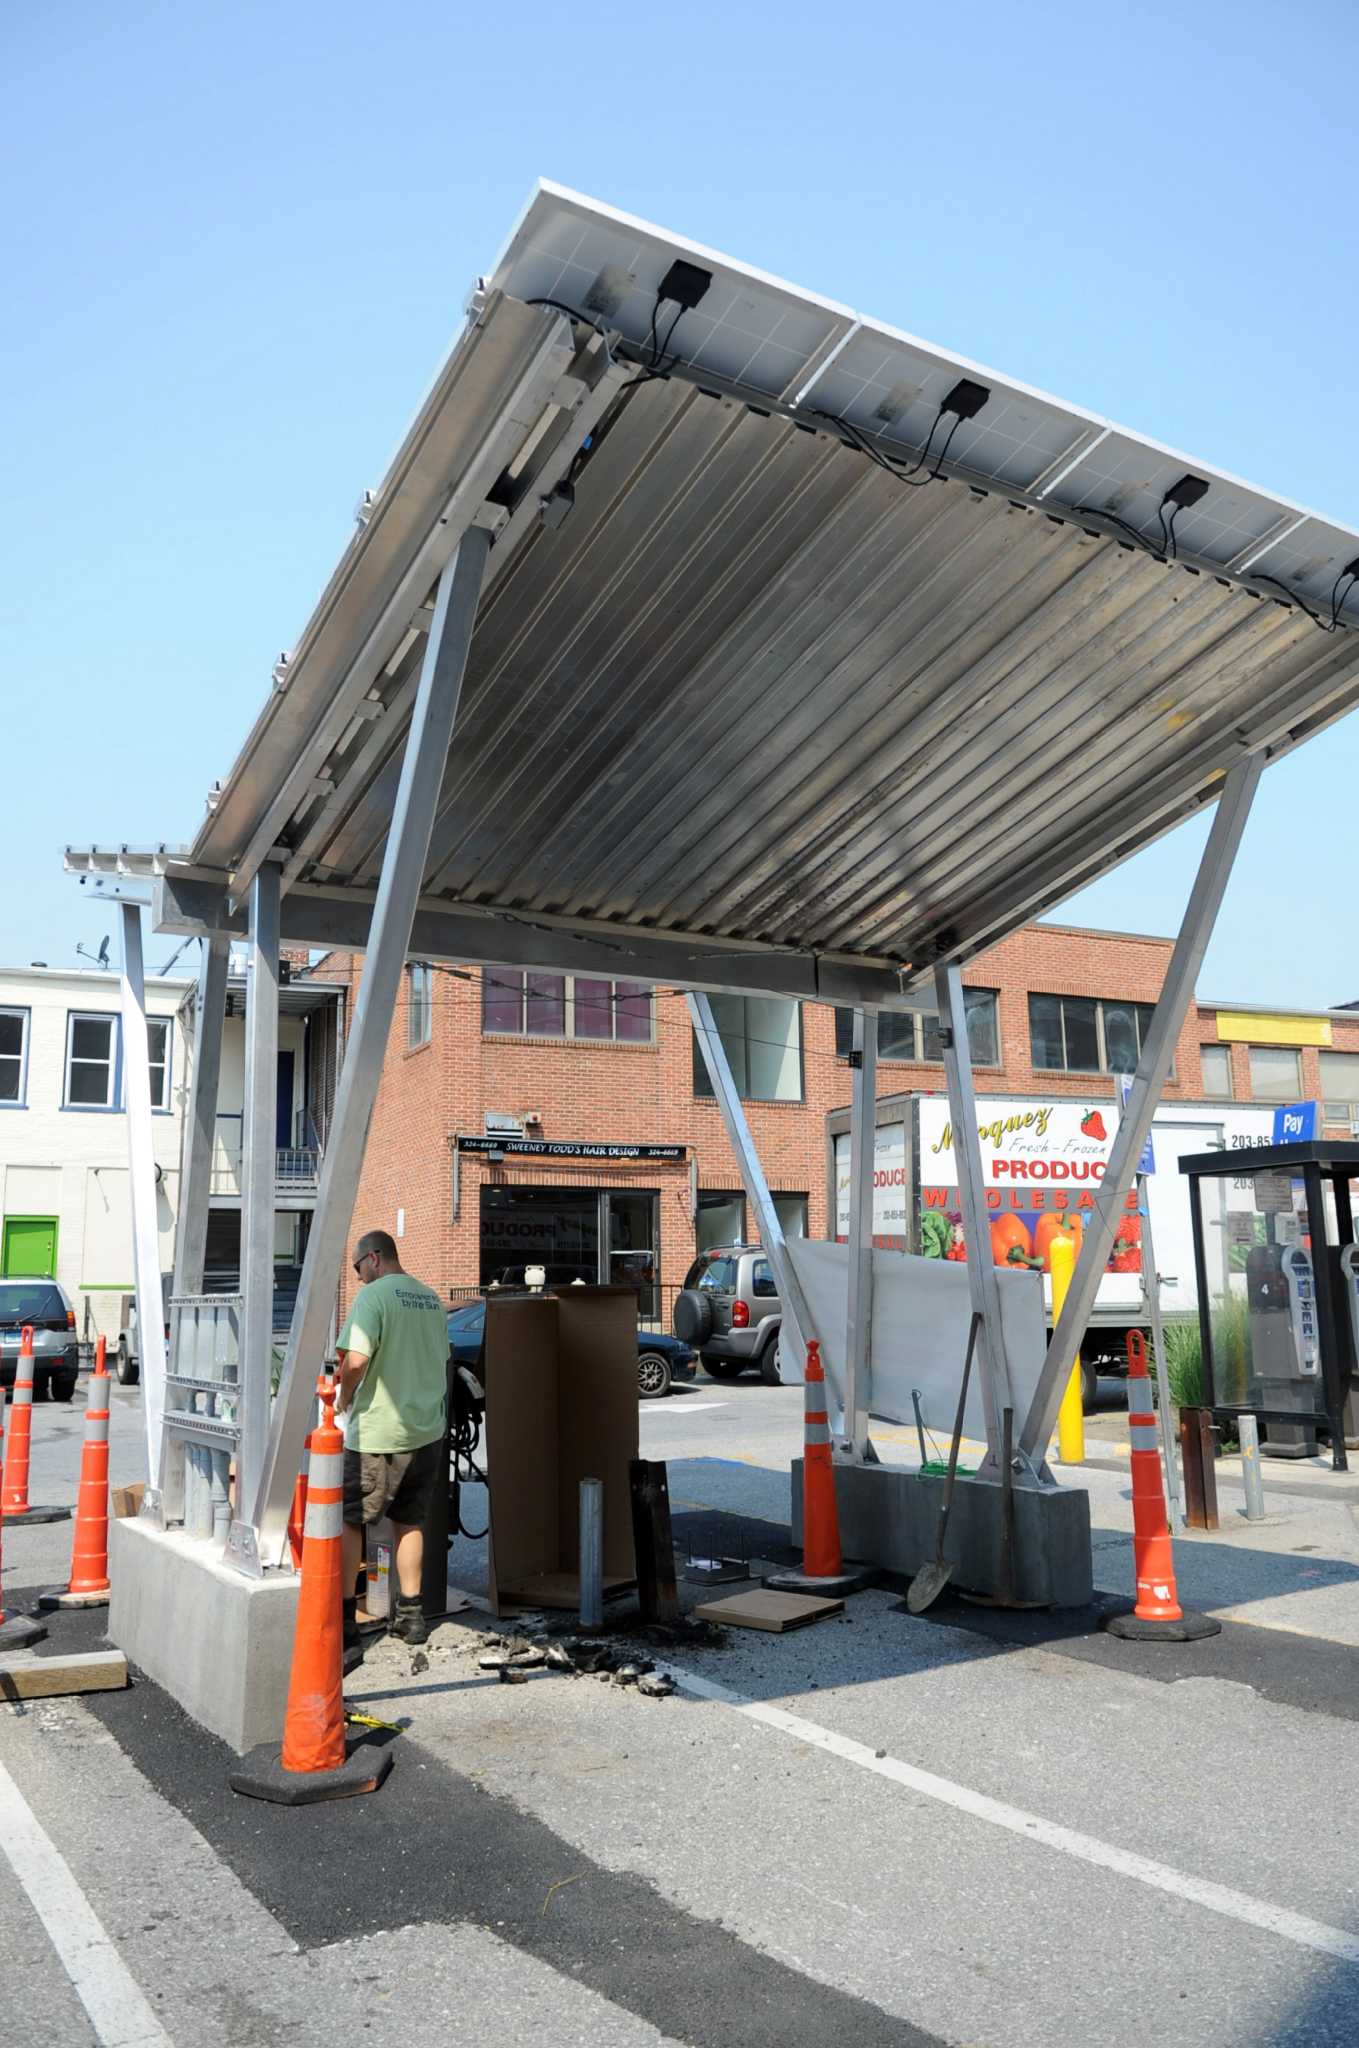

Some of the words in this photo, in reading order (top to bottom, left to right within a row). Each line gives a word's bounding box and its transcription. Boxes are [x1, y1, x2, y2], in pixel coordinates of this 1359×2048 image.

[931, 1107, 1053, 1153] Mrquez
[1283, 1114, 1303, 1135] Pay
[506, 1142, 545, 1152] SWEENEY
[548, 1144, 580, 1155] TODD'S
[583, 1146, 605, 1155] HAIR
[608, 1147, 640, 1157] DESIGN
[873, 1168, 906, 1188] ODUCE
[992, 1159, 1108, 1180] PRODUC
[923, 1188, 1138, 1209] WOLESAE
[1261, 1284, 1269, 1295] 4
